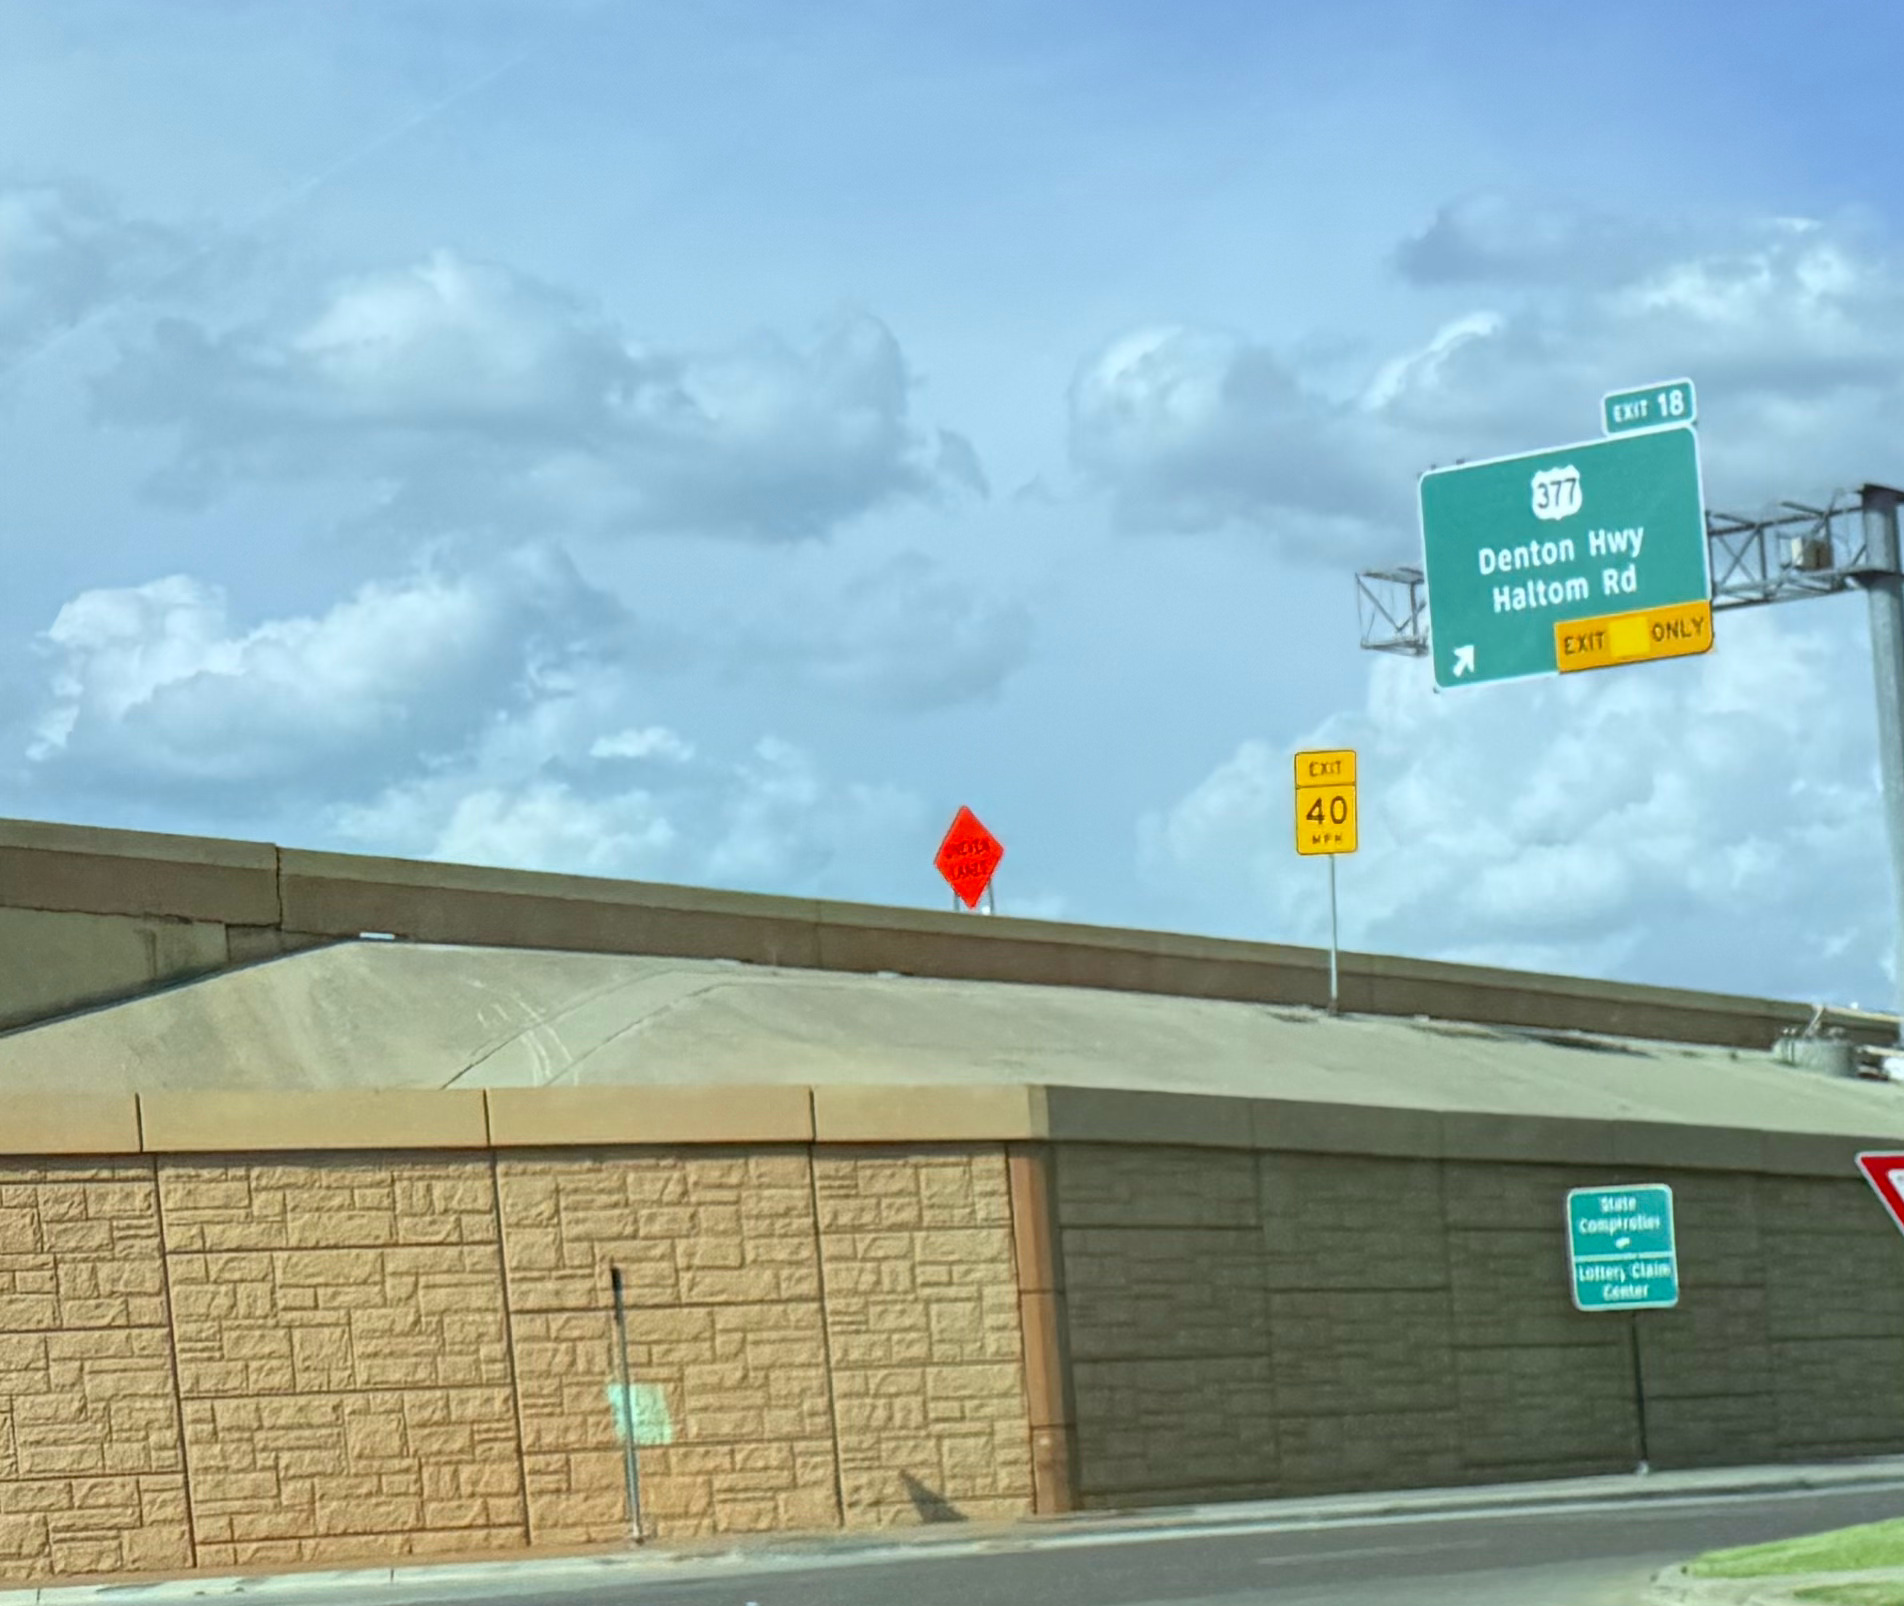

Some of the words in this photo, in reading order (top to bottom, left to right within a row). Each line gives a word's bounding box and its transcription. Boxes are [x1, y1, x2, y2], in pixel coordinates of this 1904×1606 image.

[1614, 400, 1648, 422] EXIT
[1537, 477, 1577, 509] 377
[1479, 538, 1575, 575] Denton
[1589, 526, 1644, 558] Hwy
[1493, 578, 1589, 613] Haltom
[1602, 563, 1637, 596] Rd
[1564, 631, 1606, 655] EXIT
[1652, 616, 1704, 642] ONLY
[1309, 760, 1341, 777] EXIT
[1306, 796, 1348, 825] 40
[1600, 1196, 1637, 1213] State
[1579, 1265, 1626, 1283] Lottery
[1632, 1261, 1672, 1279] Claim
[1603, 1283, 1649, 1301] Center
